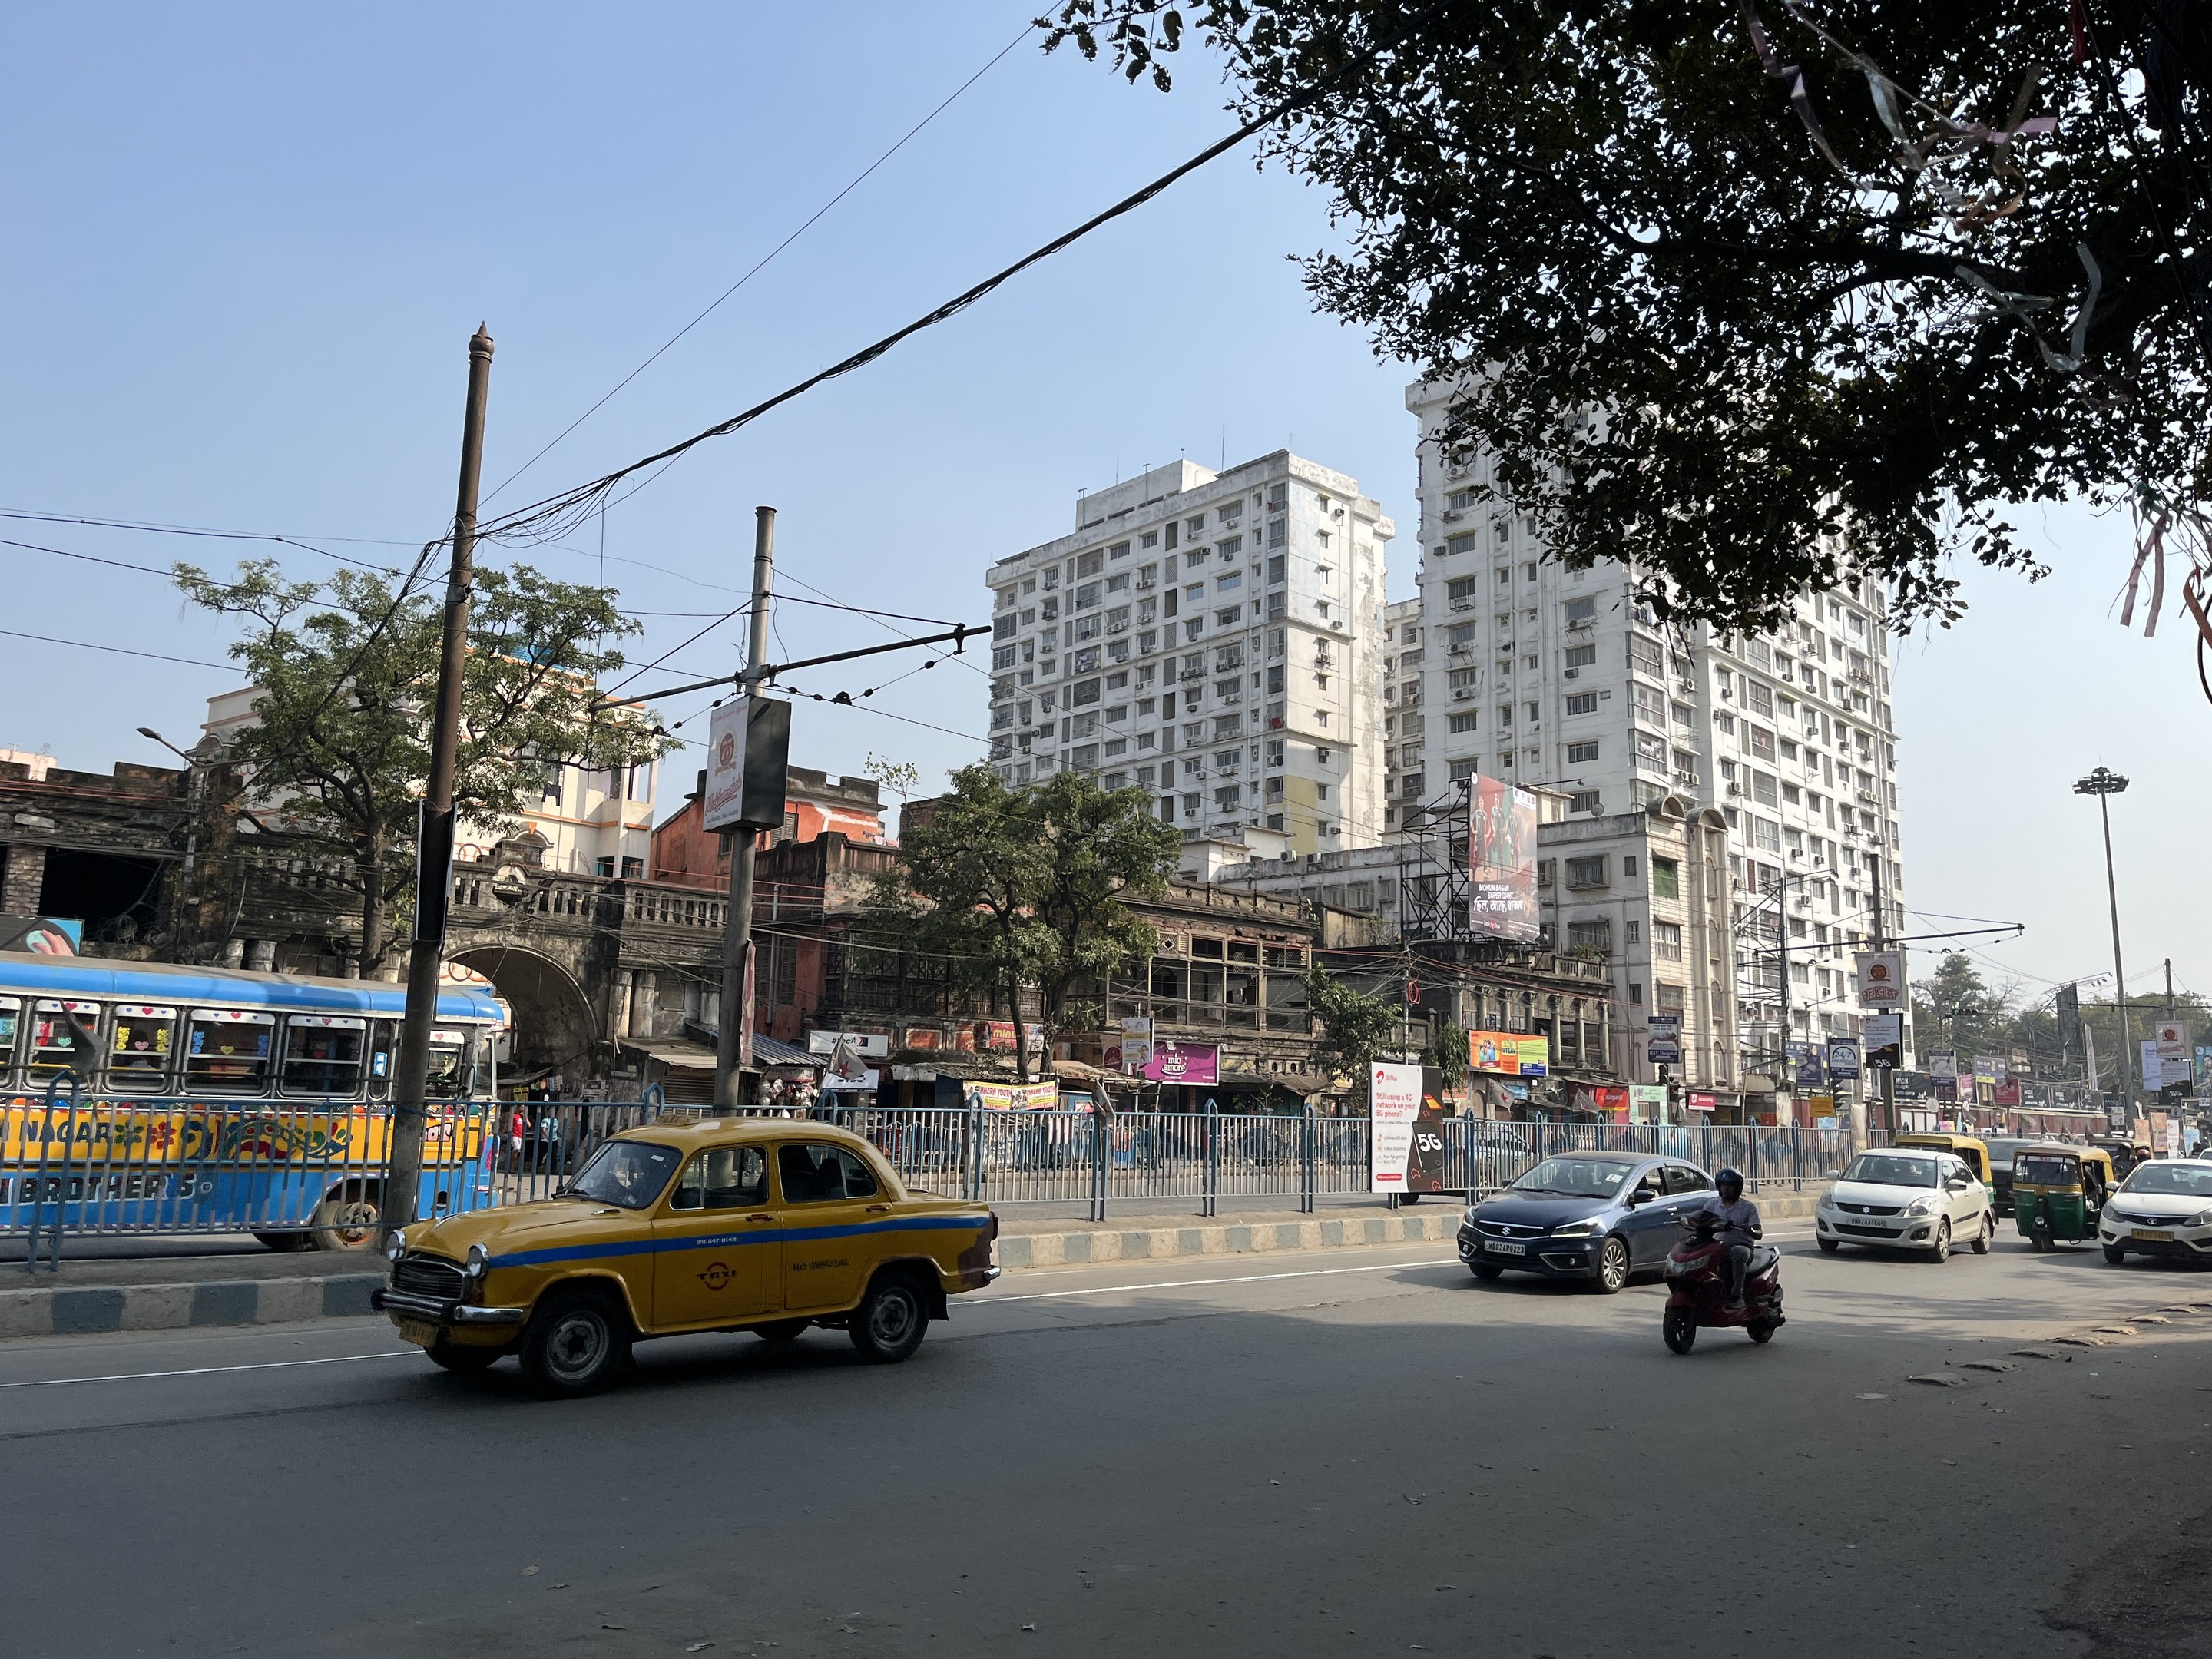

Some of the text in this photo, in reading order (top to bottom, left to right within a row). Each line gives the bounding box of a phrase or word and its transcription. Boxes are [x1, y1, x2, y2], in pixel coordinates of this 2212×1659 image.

[1479, 883, 1495, 892] MOHUN
[1167, 1055, 1181, 1064] mio
[1875, 1059, 1891, 1068] 5G
[1386, 1093, 1400, 1101] using
[19, 1120, 112, 1144] NAGAR
[1417, 1133, 1442, 1152] 5G
[697, 1269, 737, 1280] TAXI
